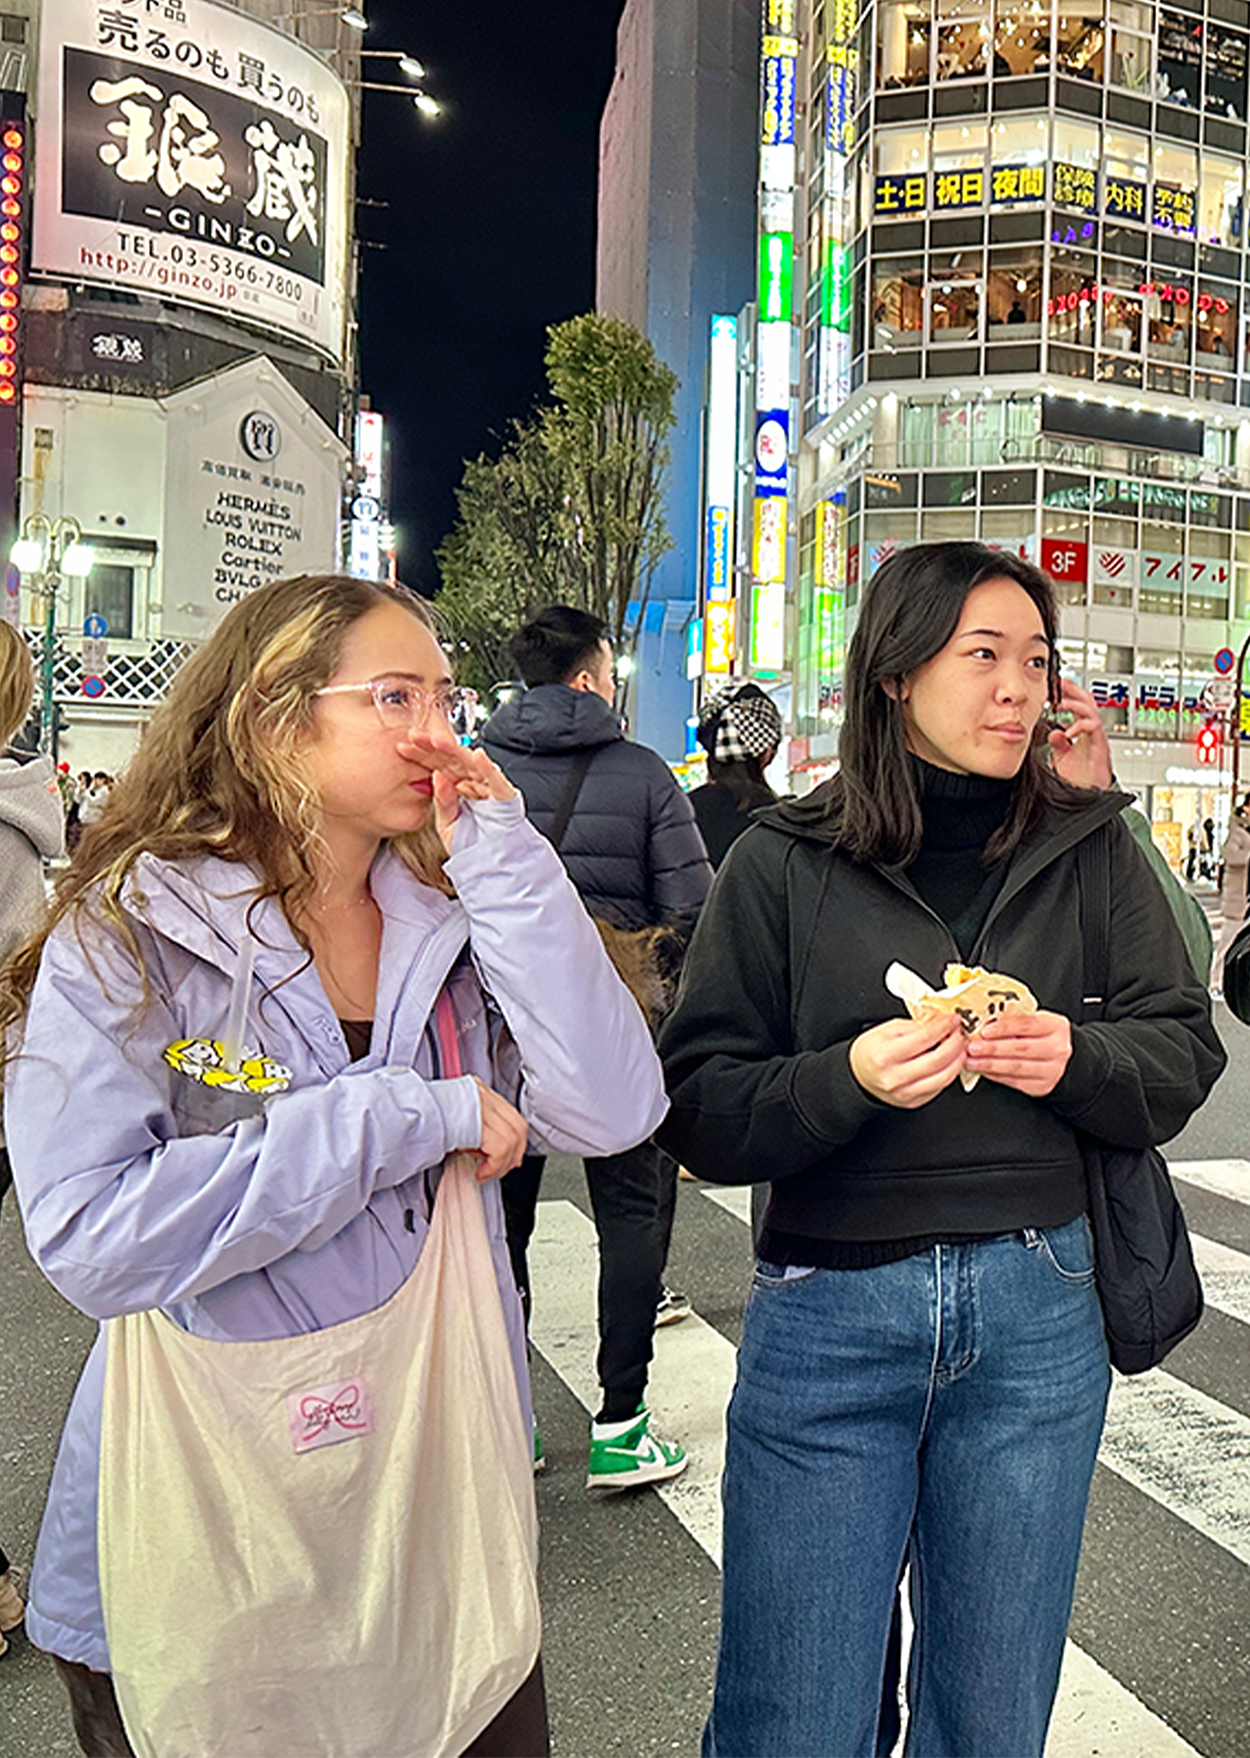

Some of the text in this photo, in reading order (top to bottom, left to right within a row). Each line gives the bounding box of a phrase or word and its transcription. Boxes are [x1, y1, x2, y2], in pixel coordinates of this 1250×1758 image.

[936, 173, 983, 206] 祝日
[993, 166, 1045, 201] 夜間
[1105, 183, 1144, 216] 内科
[80, 246, 238, 300] http://ginzo.jp
[217, 491, 291, 522] HERMÈS
[206, 508, 301, 542] LOUIS VUITTON
[225, 531, 283, 557] ROLEX
[221, 551, 284, 576] Cartier
[1051, 550, 1078, 574] 3F
